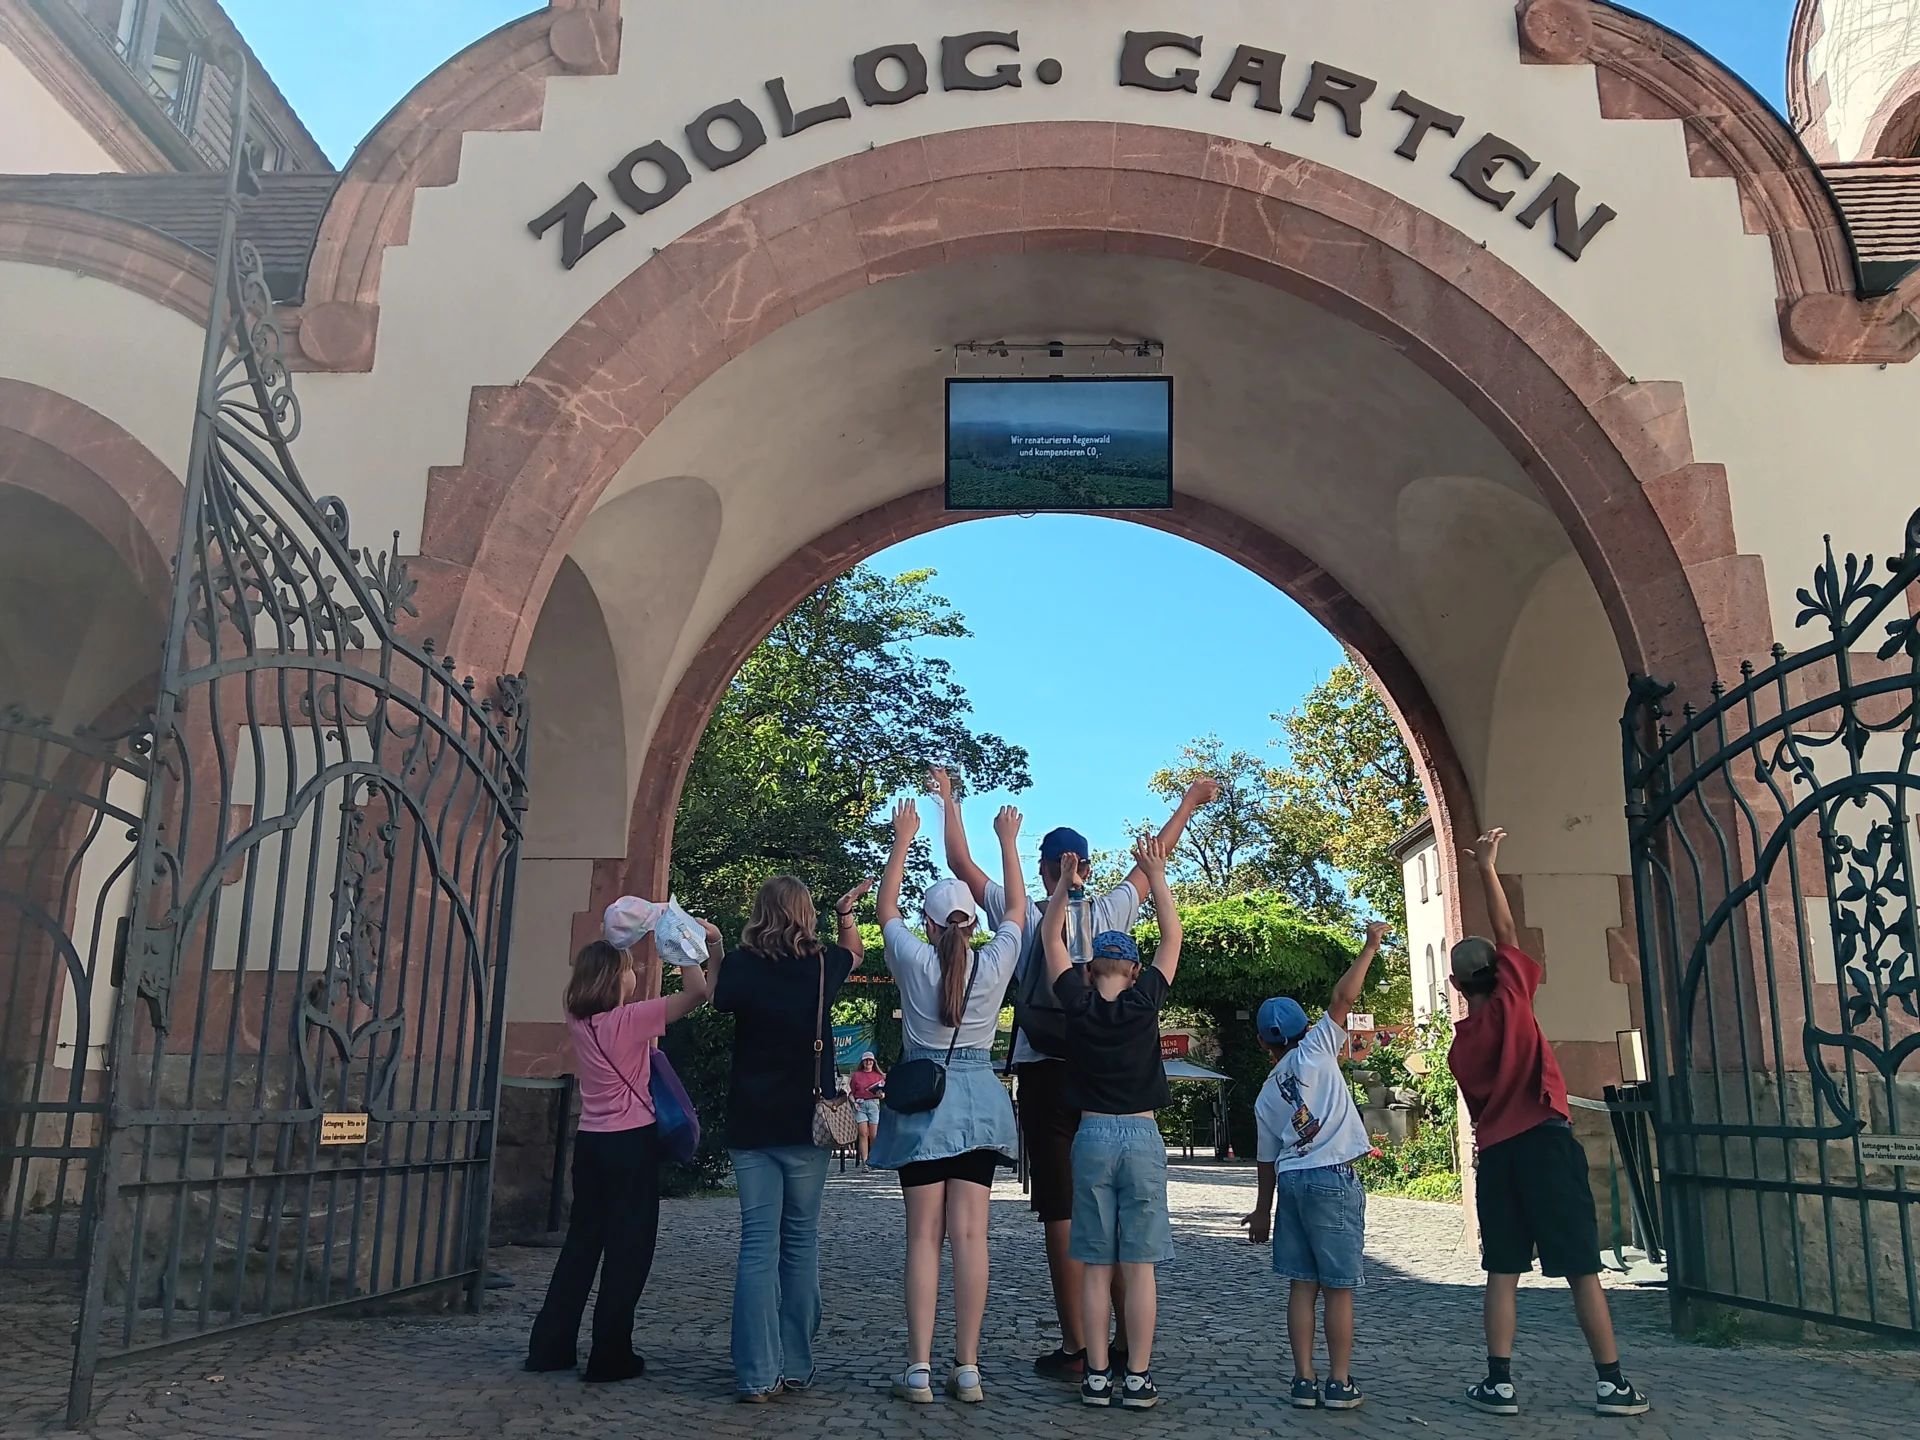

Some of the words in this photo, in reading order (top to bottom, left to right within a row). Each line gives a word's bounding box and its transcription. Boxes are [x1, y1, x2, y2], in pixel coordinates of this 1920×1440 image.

[527, 29, 1063, 270] ZOOLOG.
[1118, 30, 1618, 262] GARTEN
[1010, 435, 1023, 445] Wir
[1024, 435, 1072, 445] renaturieren
[1072, 434, 1111, 447] Regenwald
[1019, 447, 1033, 456] und
[1034, 447, 1086, 459] kompensieren
